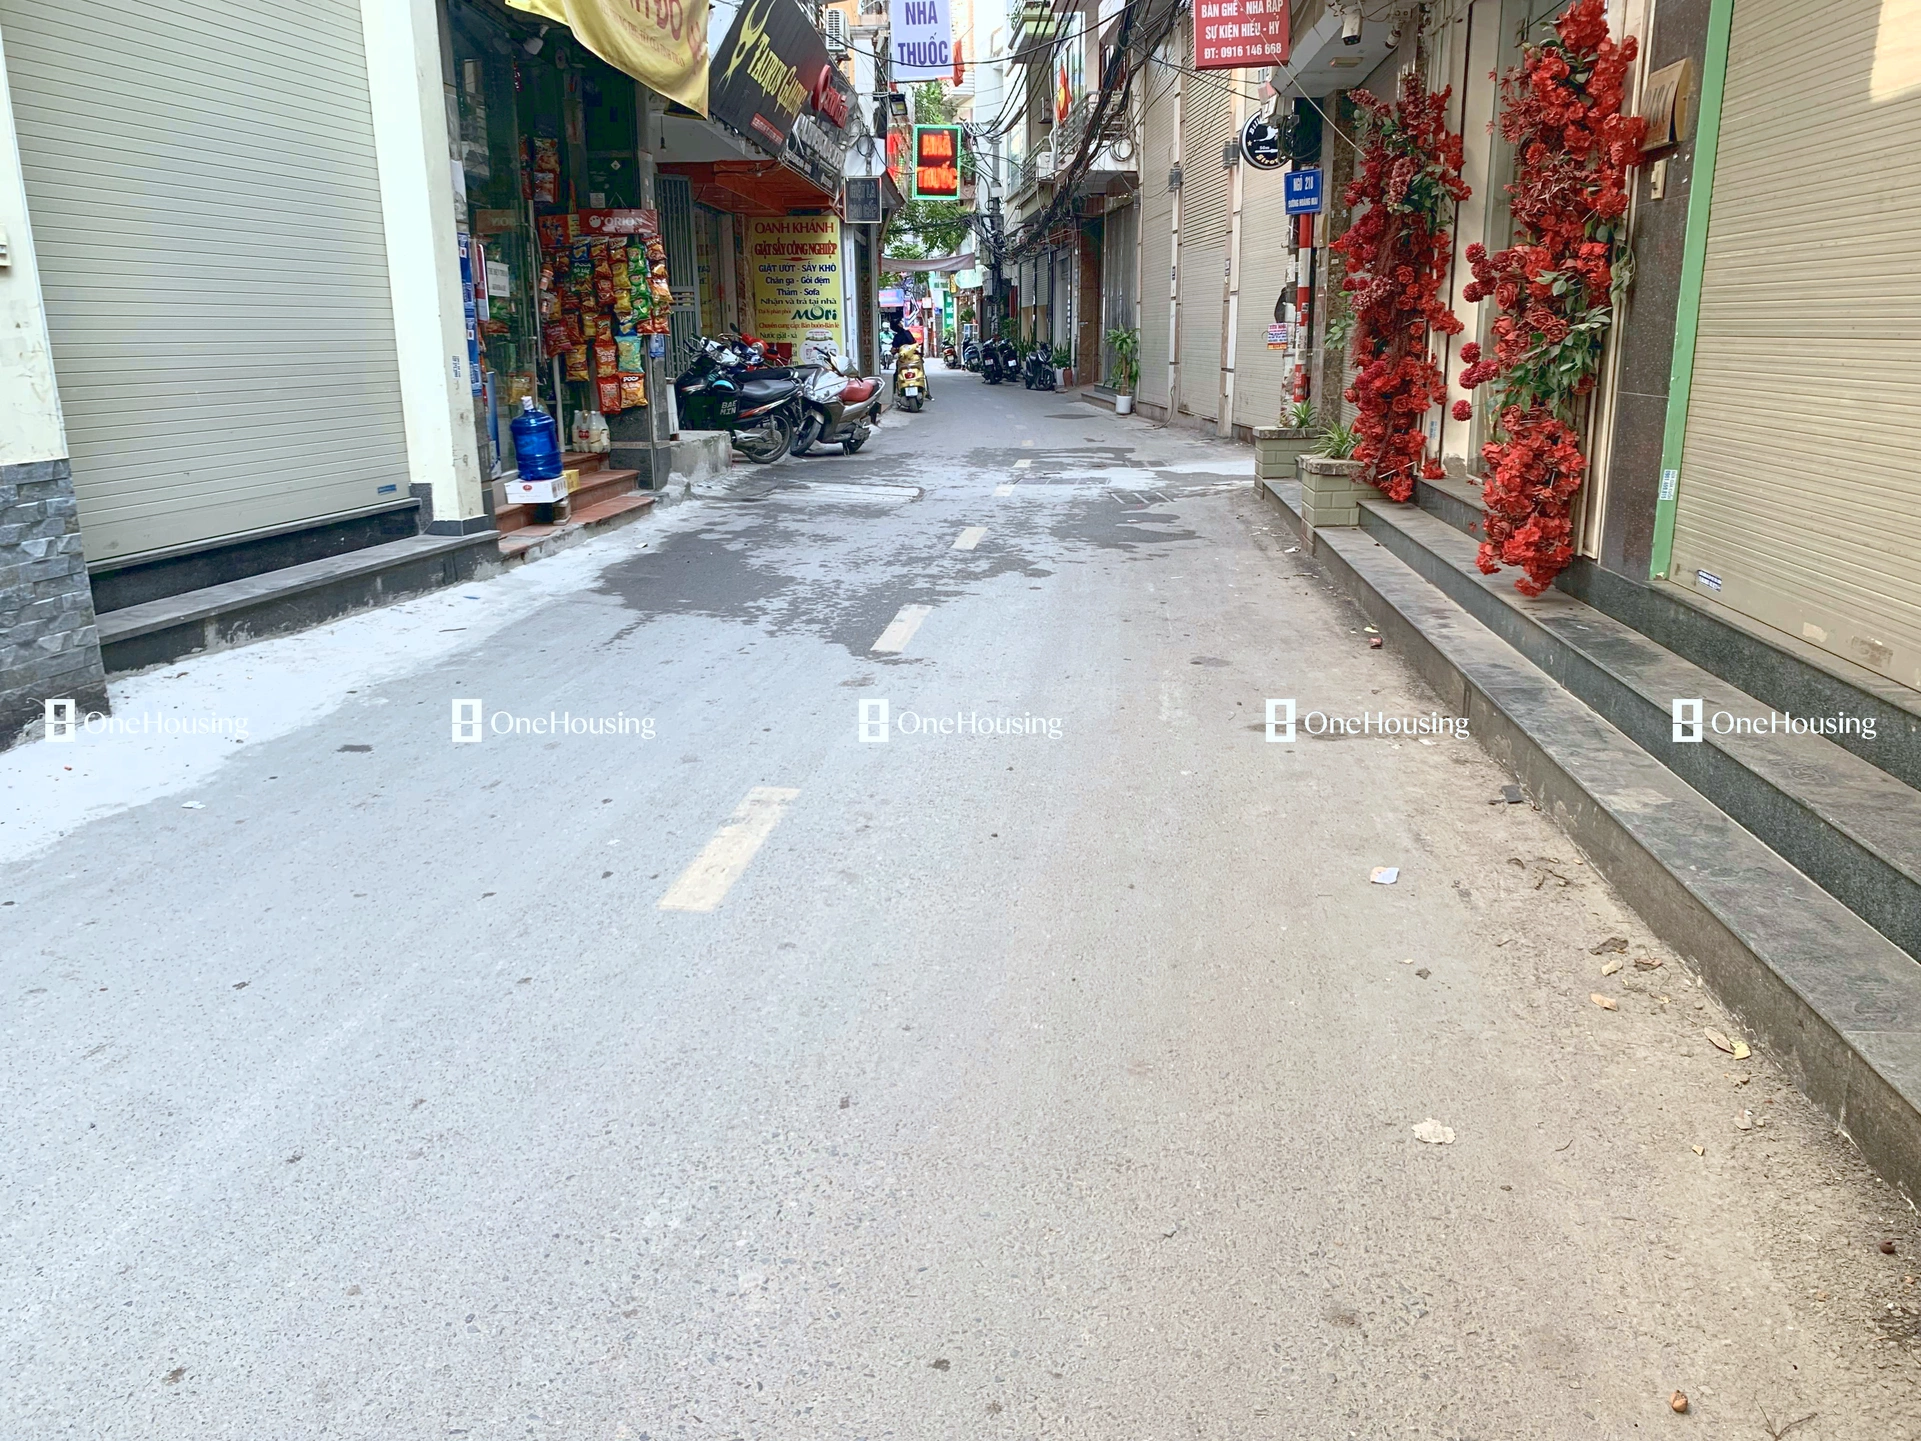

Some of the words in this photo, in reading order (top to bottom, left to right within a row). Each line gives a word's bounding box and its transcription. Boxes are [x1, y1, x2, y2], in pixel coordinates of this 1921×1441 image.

[1201, 1, 1219, 18] BÀN
[1205, 24, 1217, 42] SỰ
[1219, 22, 1239, 41] KIỆN
[1241, 18, 1261, 37] HIẾU
[898, 32, 949, 65] THUỐC
[1204, 47, 1219, 59] ĐT:
[1220, 45, 1243, 58] 0916
[1246, 44, 1262, 56] 146
[1264, 42, 1282, 55] 668
[922, 129, 952, 156] NHÀ
[917, 160, 957, 189] THUỐC
[604, 216, 643, 226] ORION
[755, 222, 790, 234] OANH
[792, 219, 834, 234] KHÁNH
[801, 261, 817, 272] SẤY
[785, 278, 794, 286] ga
[803, 288, 820, 296] Sofa
